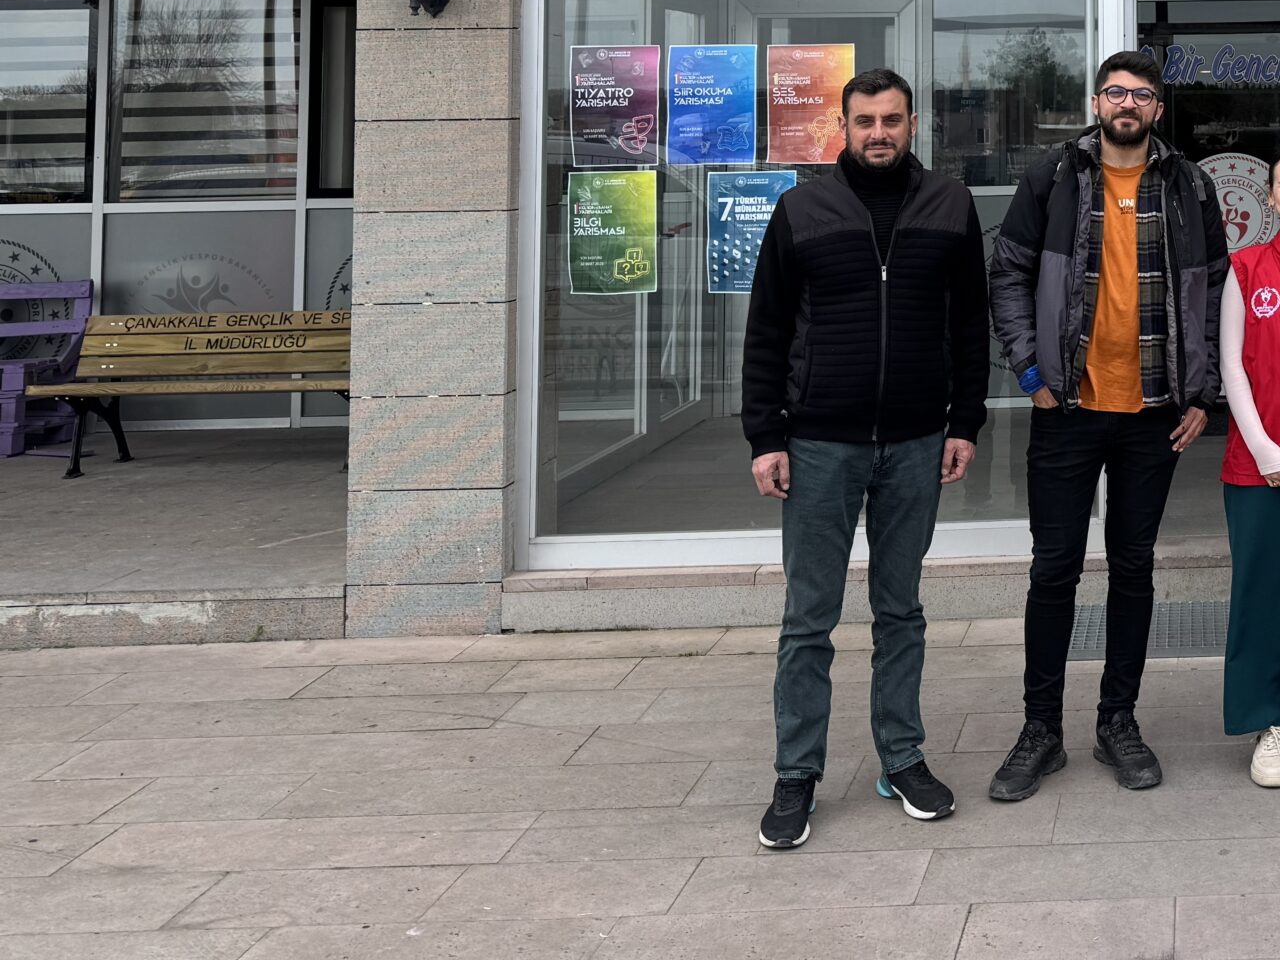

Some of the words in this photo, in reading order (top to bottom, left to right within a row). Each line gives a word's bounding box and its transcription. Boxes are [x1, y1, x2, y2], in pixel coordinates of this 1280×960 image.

[1162, 43, 1205, 85] Bir
[694, 87, 733, 96] OKUMA
[773, 87, 796, 97] SES
[1221, 178, 1253, 192] GENÇLİK
[734, 195, 768, 205] TÜRKİYE
[124, 315, 218, 332] ÇANAKKALE
[226, 311, 294, 329] GENÇLİK
[303, 312, 323, 325] VE
[184, 335, 198, 351] İL
[205, 334, 307, 350] MÜDÜRLÜĞÜ
